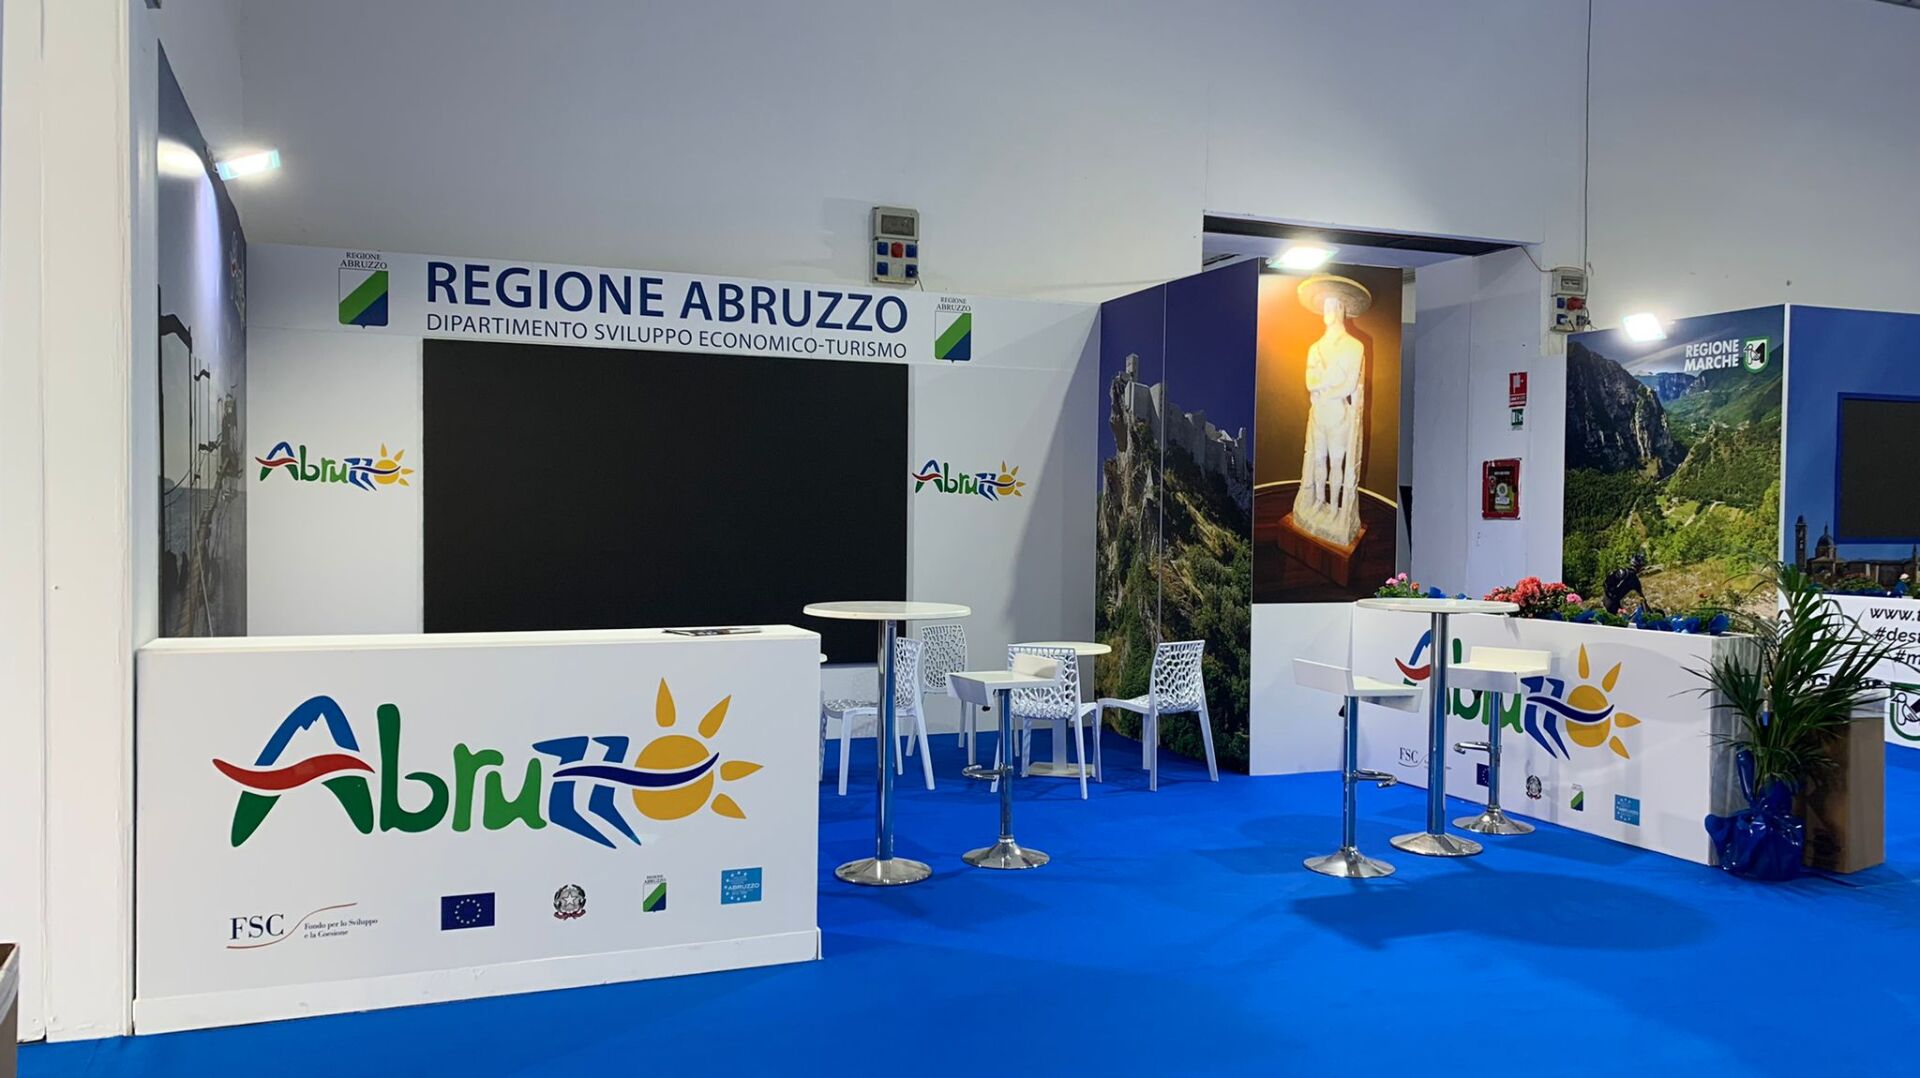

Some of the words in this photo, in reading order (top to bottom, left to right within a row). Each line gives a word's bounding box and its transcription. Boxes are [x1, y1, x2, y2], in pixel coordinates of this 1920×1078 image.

[340, 259, 388, 270] ABRUZZO
[345, 251, 382, 260] REGIONE
[427, 260, 665, 319] REGIONE
[679, 280, 908, 334] ABRUZZO
[936, 303, 972, 312] ABRUZZO
[427, 313, 588, 339] DIPARTIMENTO
[594, 323, 693, 346] SVILUPPO
[699, 330, 907, 359] ECONOMICO-TURISMO
[1685, 338, 1740, 359] REGIONE
[1683, 353, 1740, 373] MARCHE
[255, 441, 415, 491] Abruzzo
[912, 459, 1026, 501] Abruzzo
[212, 677, 764, 848] Abruzzo
[1399, 747, 1418, 764] FSC
[728, 882, 760, 891] ABRUZZO
[229, 913, 285, 940] FSC
[304, 922, 326, 930] Fondo
[327, 922, 339, 930] per
[348, 918, 378, 927] Sviluppo
[309, 931, 317, 939] la
[317, 930, 349, 938] Coesione
